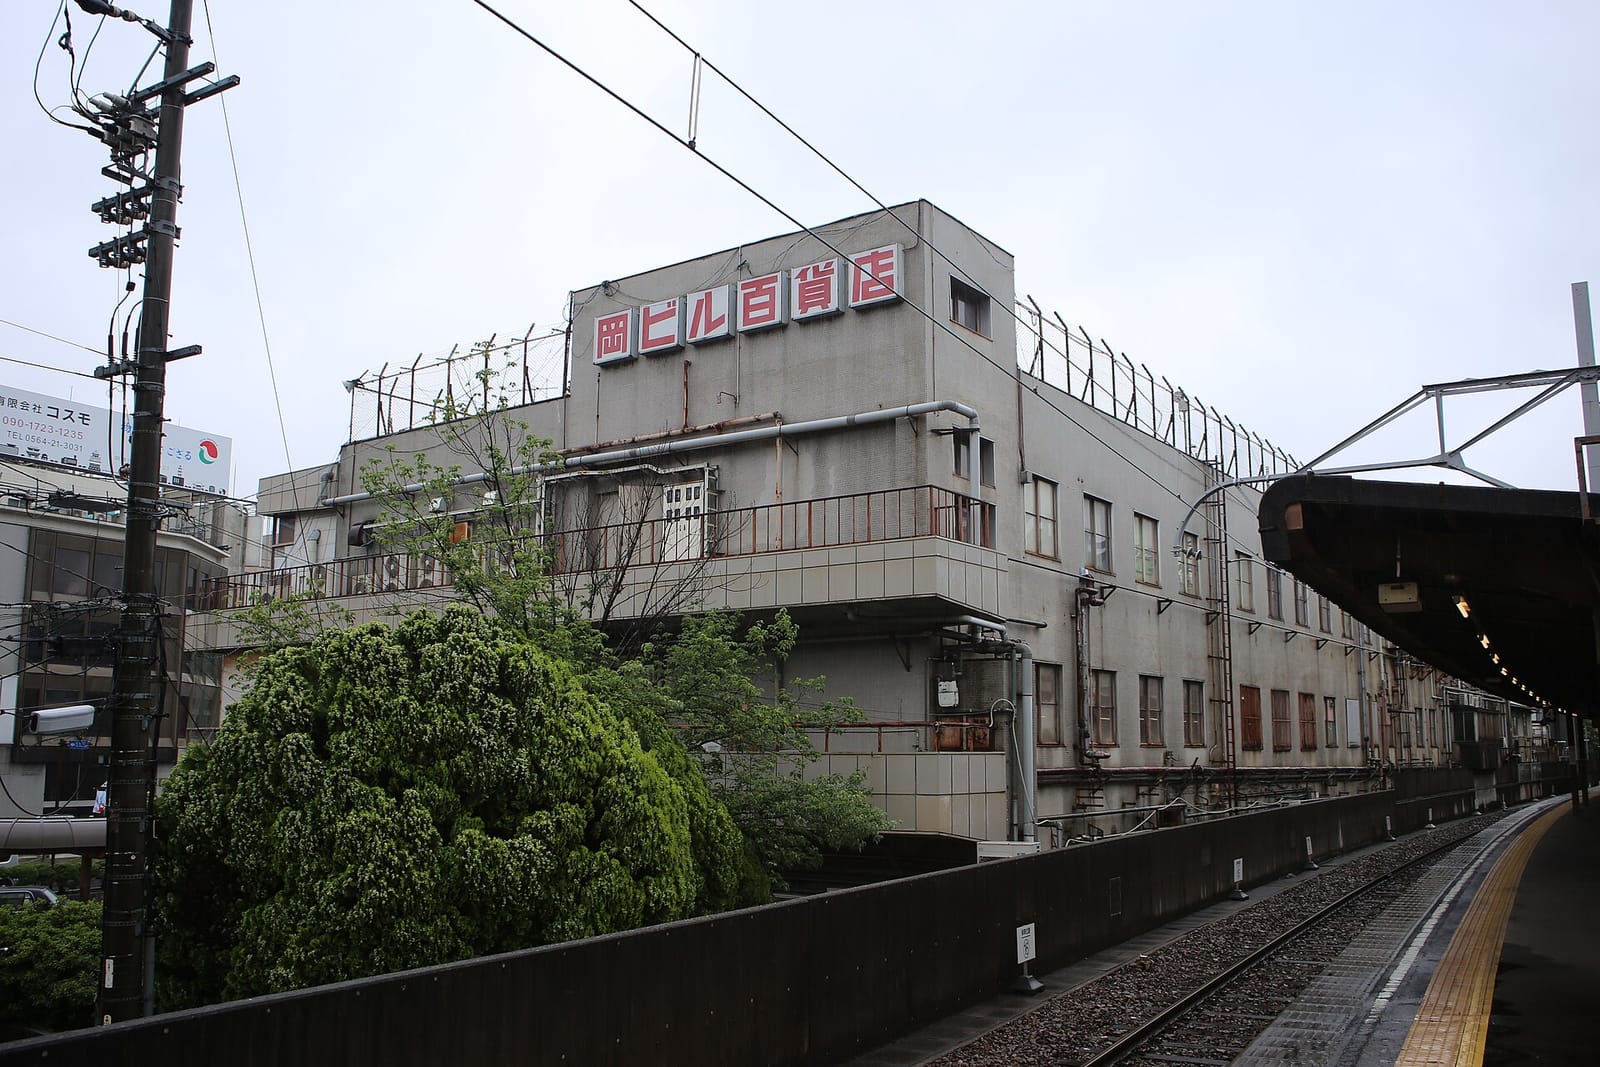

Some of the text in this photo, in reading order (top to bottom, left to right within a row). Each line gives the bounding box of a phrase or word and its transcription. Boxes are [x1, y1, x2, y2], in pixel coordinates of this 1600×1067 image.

[597, 250, 896, 359] 岡ビル百貨店
[2, 416, 84, 440] 090-1723-1235
